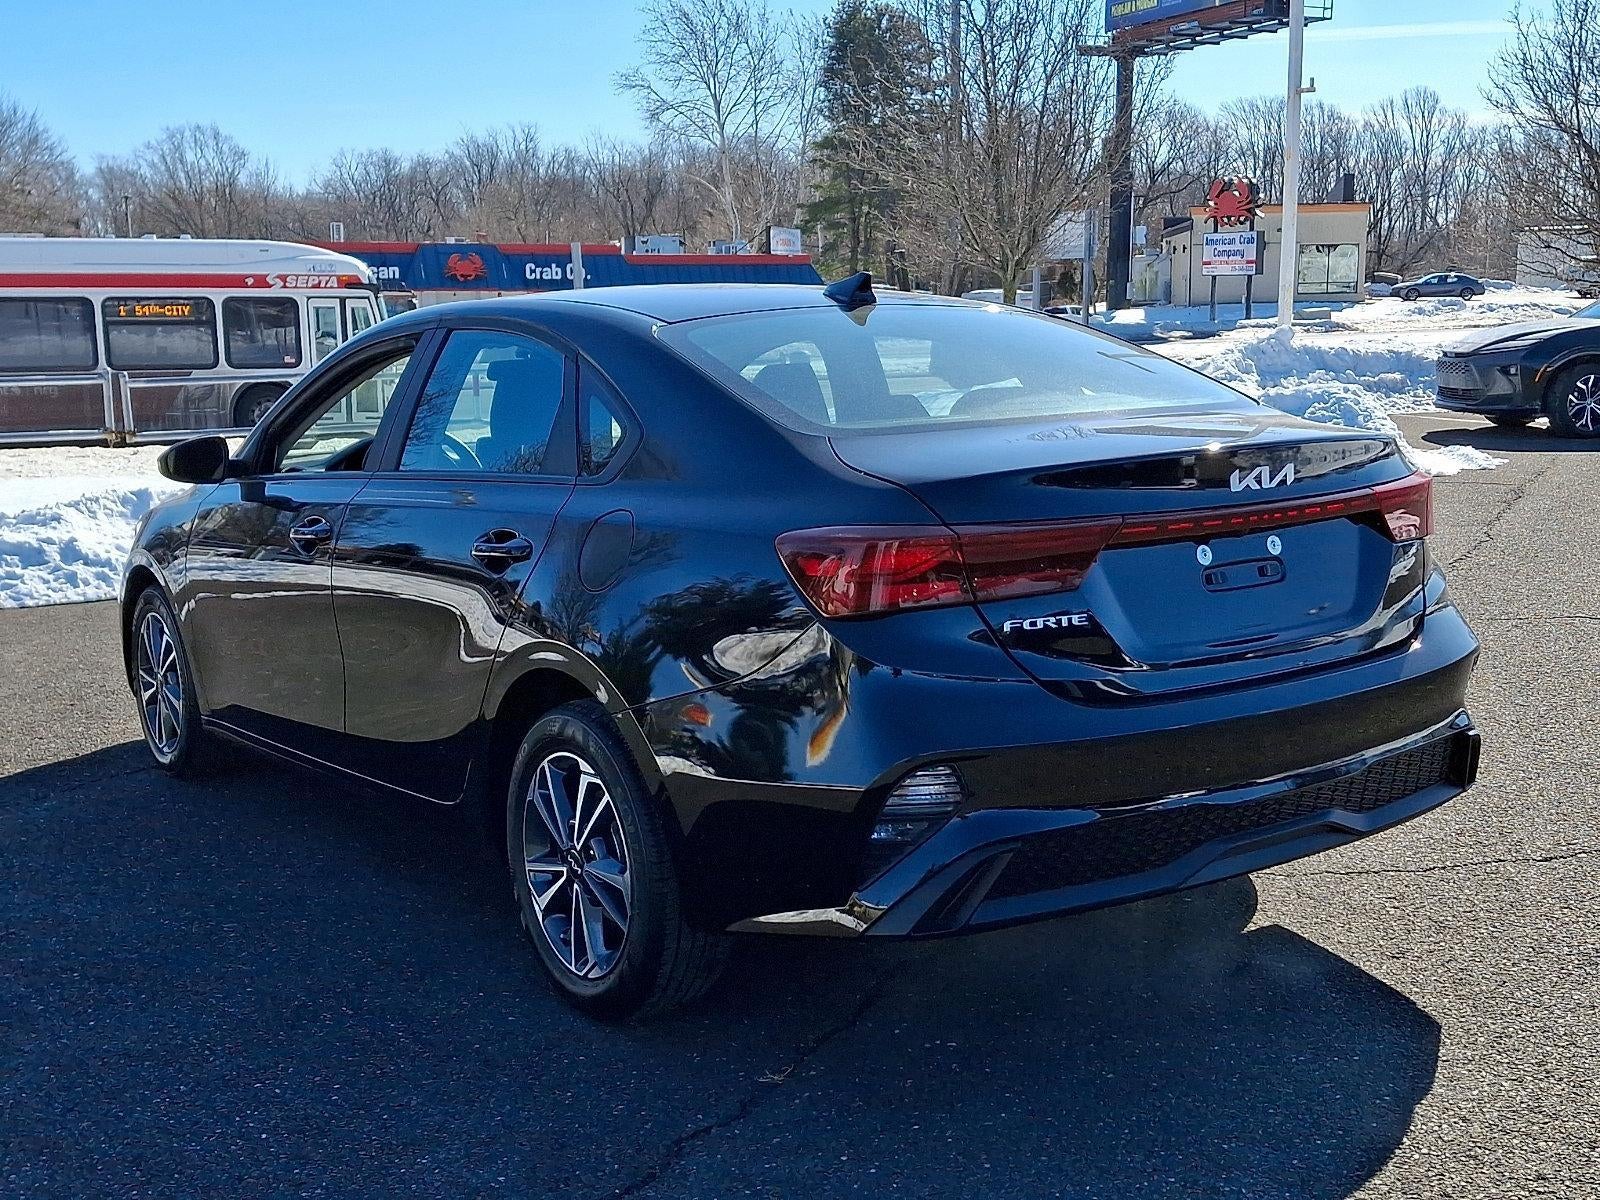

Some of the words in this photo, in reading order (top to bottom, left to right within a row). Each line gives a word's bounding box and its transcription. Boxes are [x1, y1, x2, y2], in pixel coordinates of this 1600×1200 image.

[1205, 236, 1236, 247] American
[1239, 234, 1255, 245] Crab
[1213, 247, 1245, 259] Company
[525, 263, 562, 280] Crab
[285, 275, 339, 288] SEPTA
[118, 305, 127, 317] 1
[1230, 462, 1295, 492] KIA
[1003, 614, 1089, 633] FORTE
